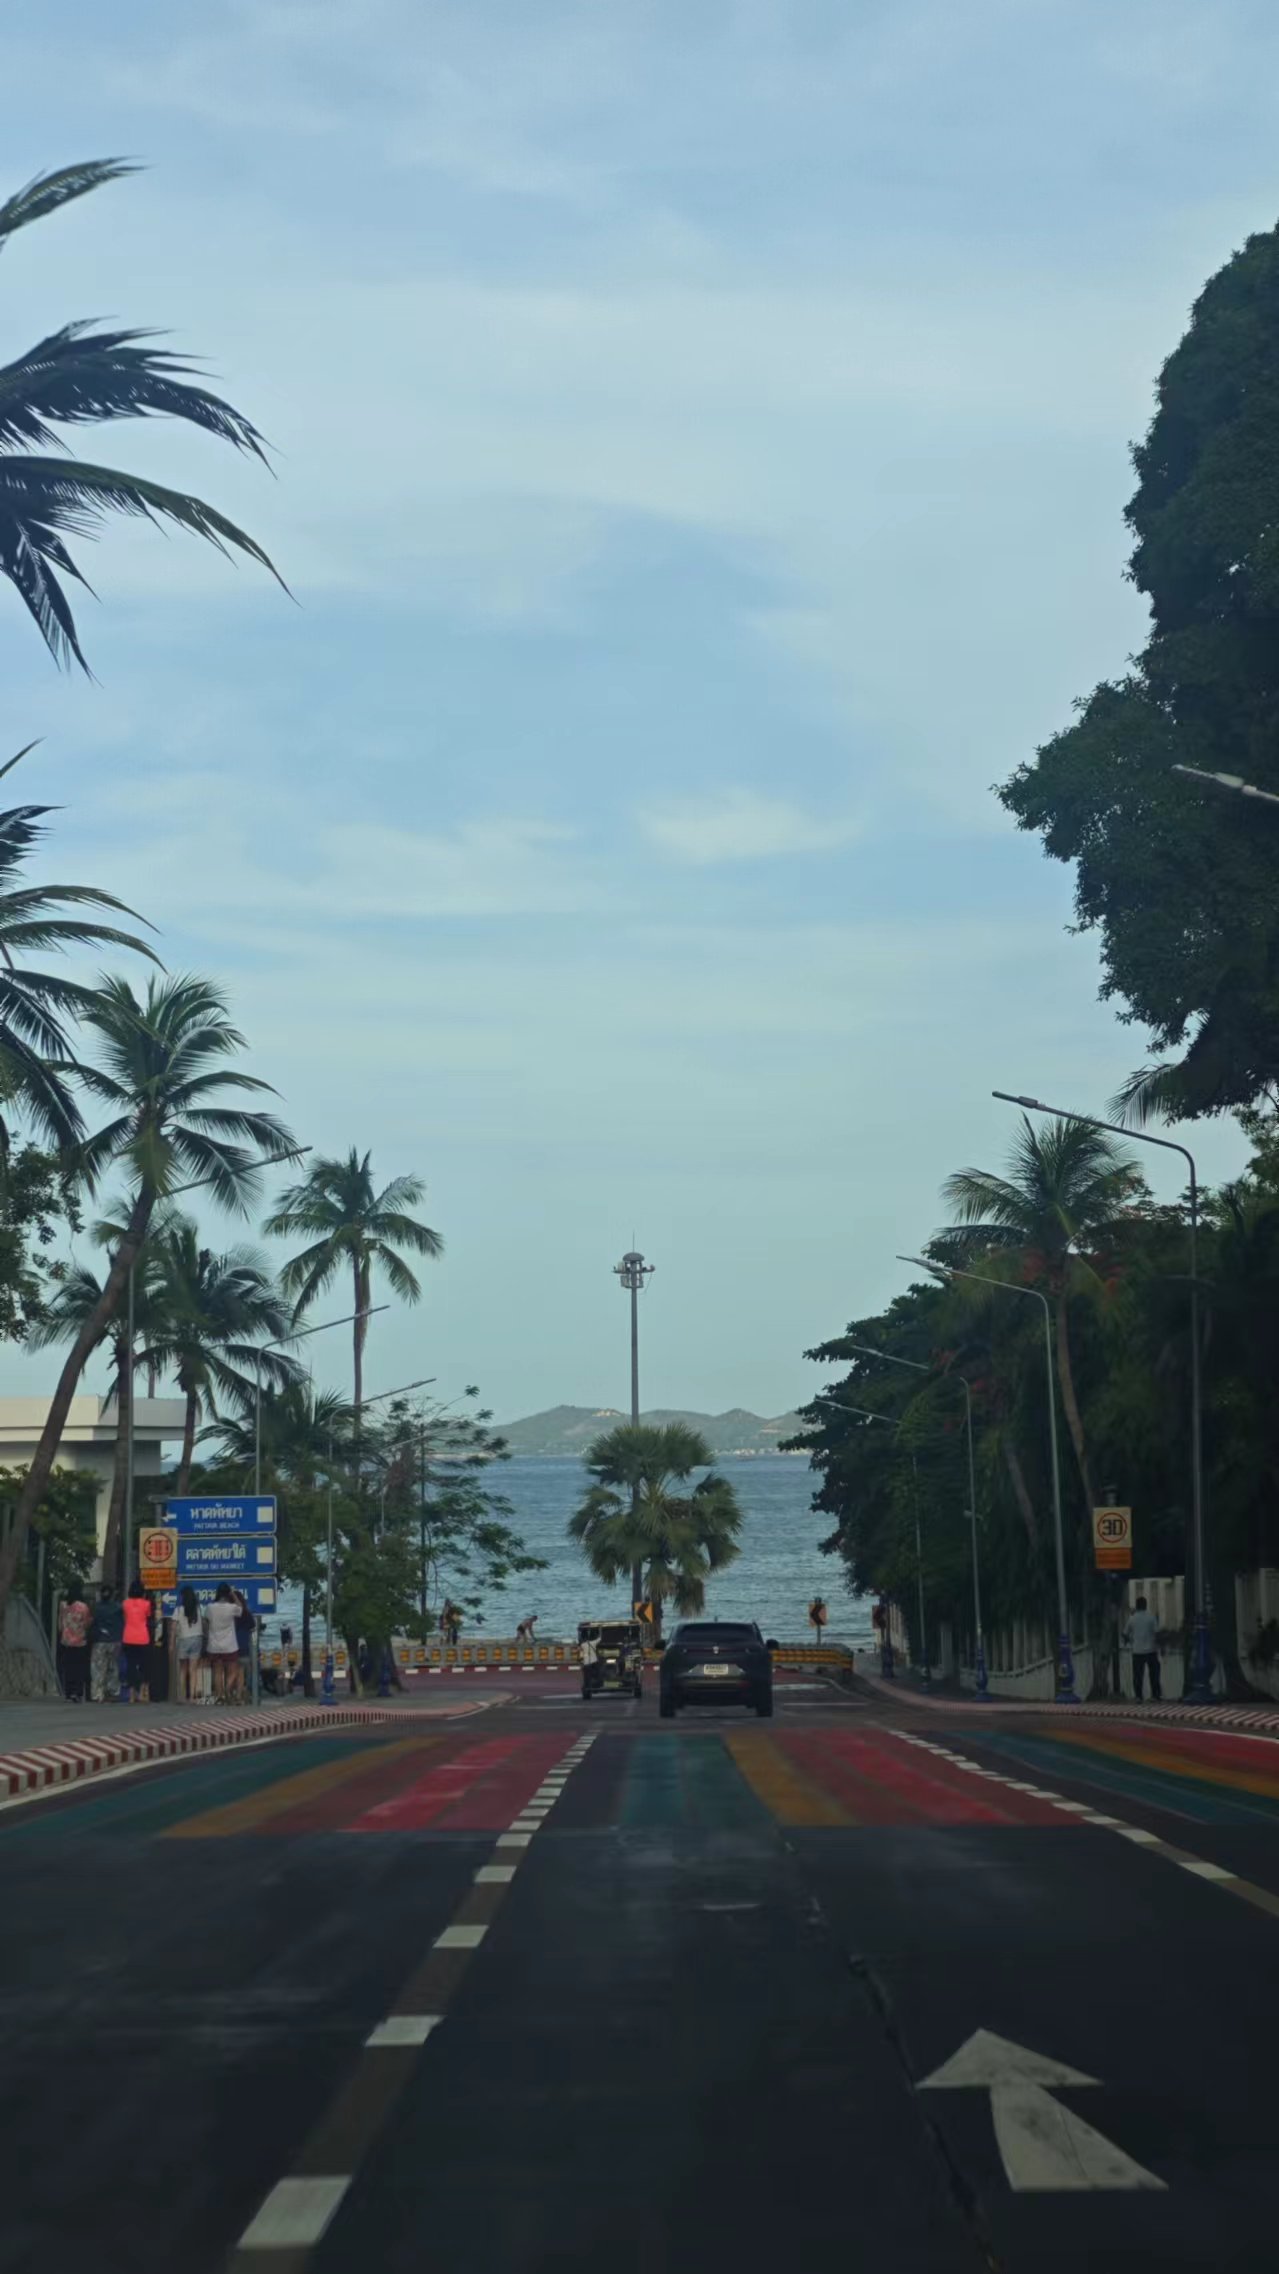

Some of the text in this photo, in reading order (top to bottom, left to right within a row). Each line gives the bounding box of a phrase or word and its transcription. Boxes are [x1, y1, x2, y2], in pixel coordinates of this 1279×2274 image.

[190, 1502, 242, 1519] หาดพัทยา
[1102, 1519, 1123, 1536] 30
